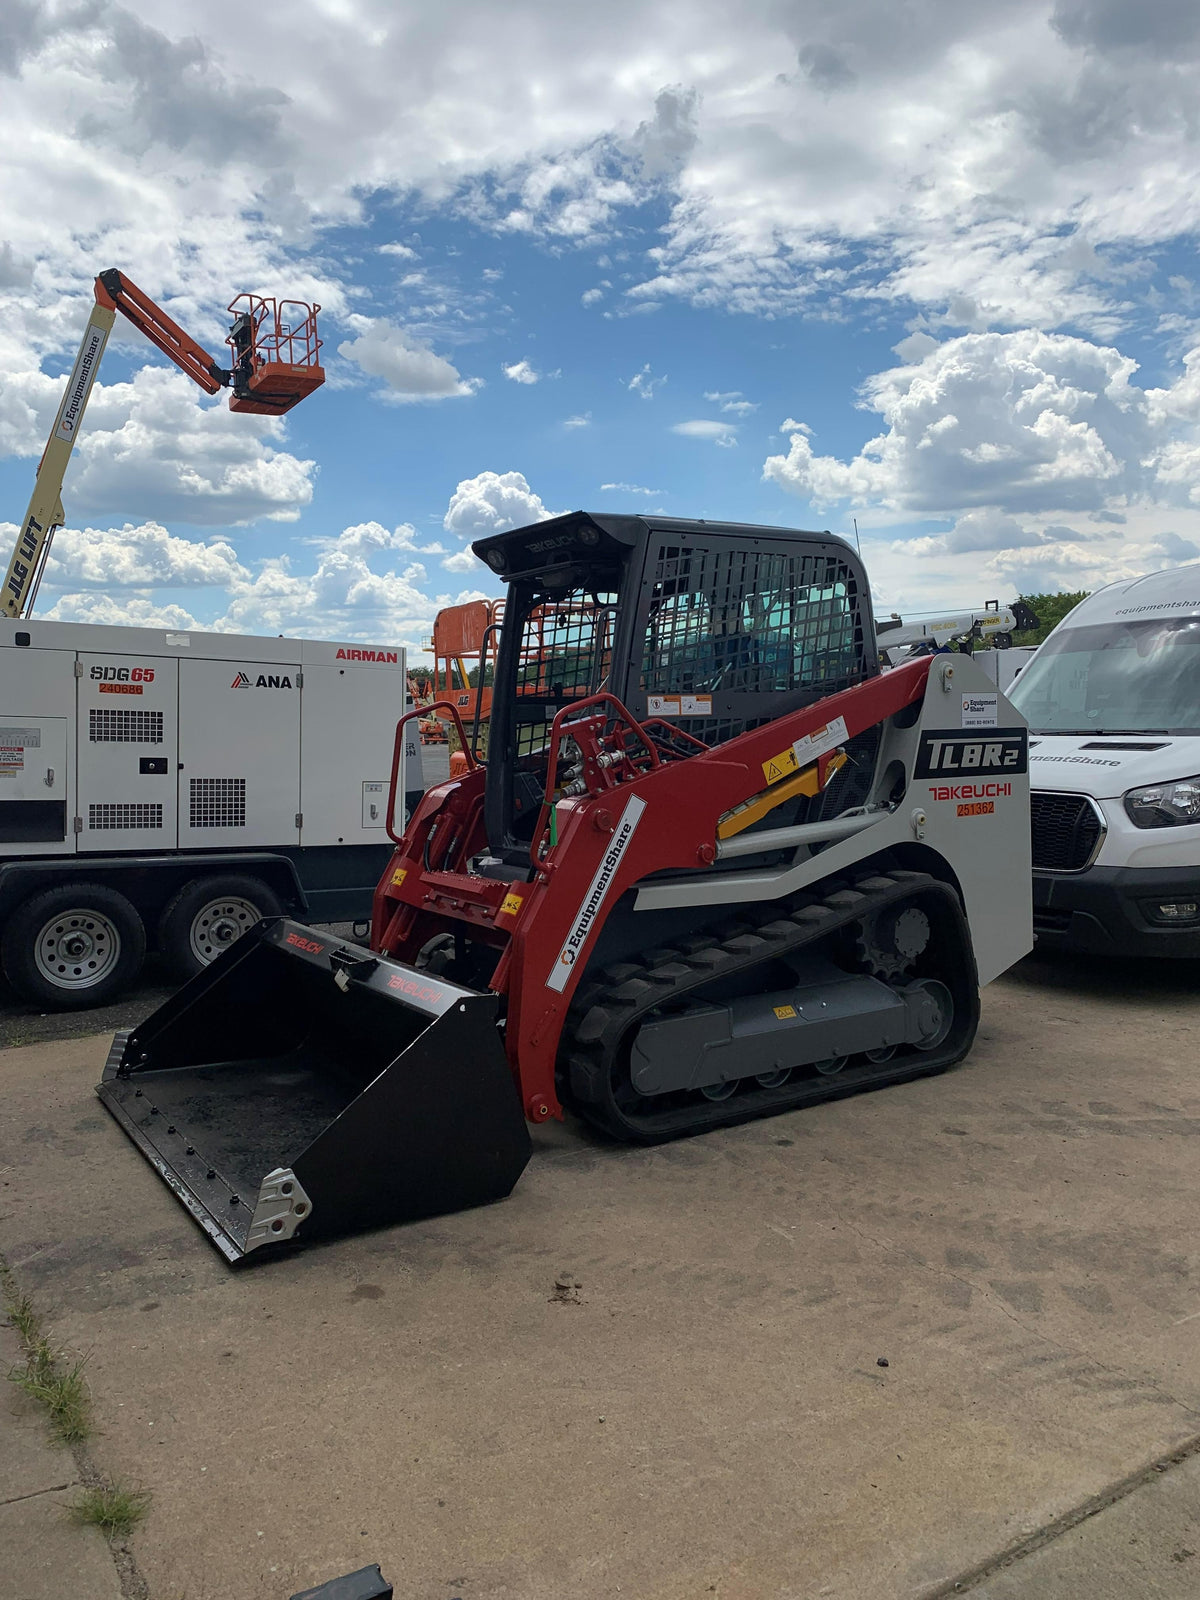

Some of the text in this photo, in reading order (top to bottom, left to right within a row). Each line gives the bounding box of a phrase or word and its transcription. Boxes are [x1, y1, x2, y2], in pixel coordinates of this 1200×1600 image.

[66, 335, 100, 420] EquipmentShare
[8, 515, 43, 600] JLG LIFT
[336, 648, 398, 663] AIRMAN
[99, 683, 143, 694] 240686
[255, 675, 292, 688] ANA
[458, 694, 469, 706] JLG
[957, 801, 994, 817] 251362
[568, 823, 632, 949] EquipmentShare
